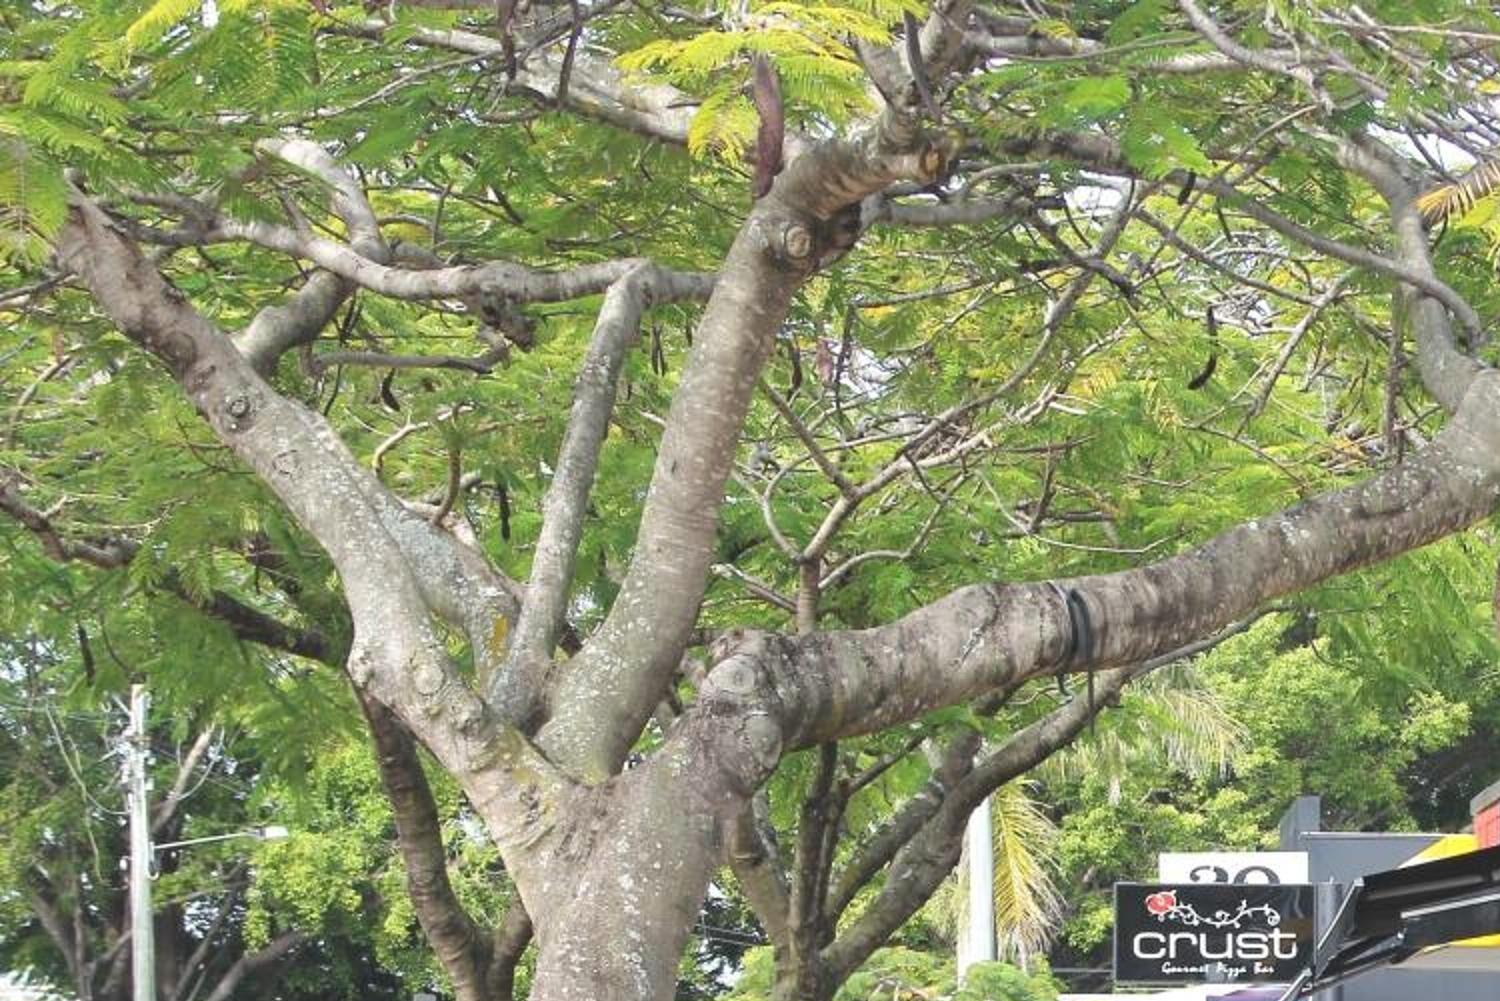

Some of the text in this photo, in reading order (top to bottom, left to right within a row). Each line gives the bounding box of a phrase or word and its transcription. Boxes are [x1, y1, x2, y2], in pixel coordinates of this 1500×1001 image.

[1133, 927, 1298, 960] crust
[1161, 961, 1275, 977] Gourmet Pizza Bar
